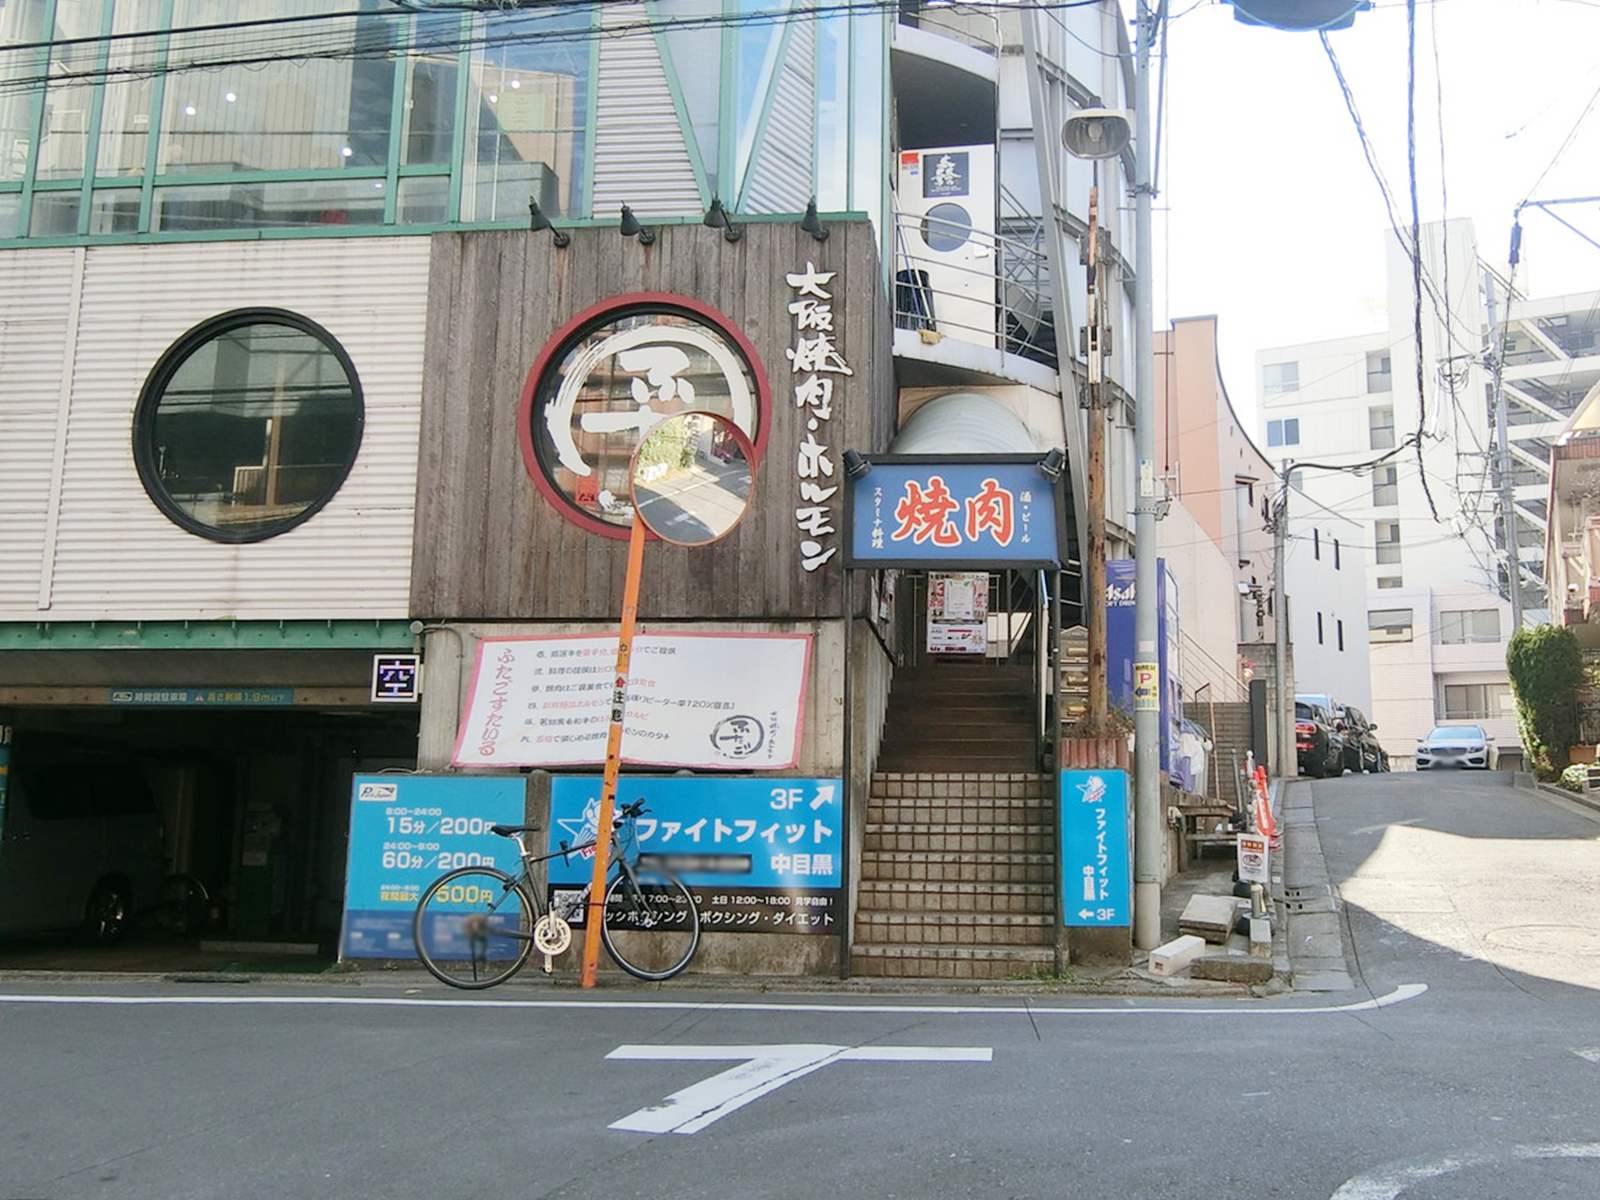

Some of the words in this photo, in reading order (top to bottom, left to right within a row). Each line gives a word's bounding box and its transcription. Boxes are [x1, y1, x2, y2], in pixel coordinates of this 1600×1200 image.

[786, 261, 854, 572] 大阪焼肉・ホルモン
[891, 476, 1014, 547] 焼肉
[379, 660, 415, 697] 空
[1141, 673, 1152, 684] P
[478, 648, 515, 756] ふたごすたいる
[770, 788, 803, 810] 3F
[637, 818, 832, 844] ファイトフィット
[382, 851, 495, 869] 60分/200円
[770, 853, 833, 876] 中目黒
[1095, 808, 1109, 901] ファイトフィット
[436, 885, 493, 904] 500円
[1083, 865, 1095, 901] 中目黒
[711, 895, 728, 905] 土日
[1096, 908, 1115, 920] 3F
